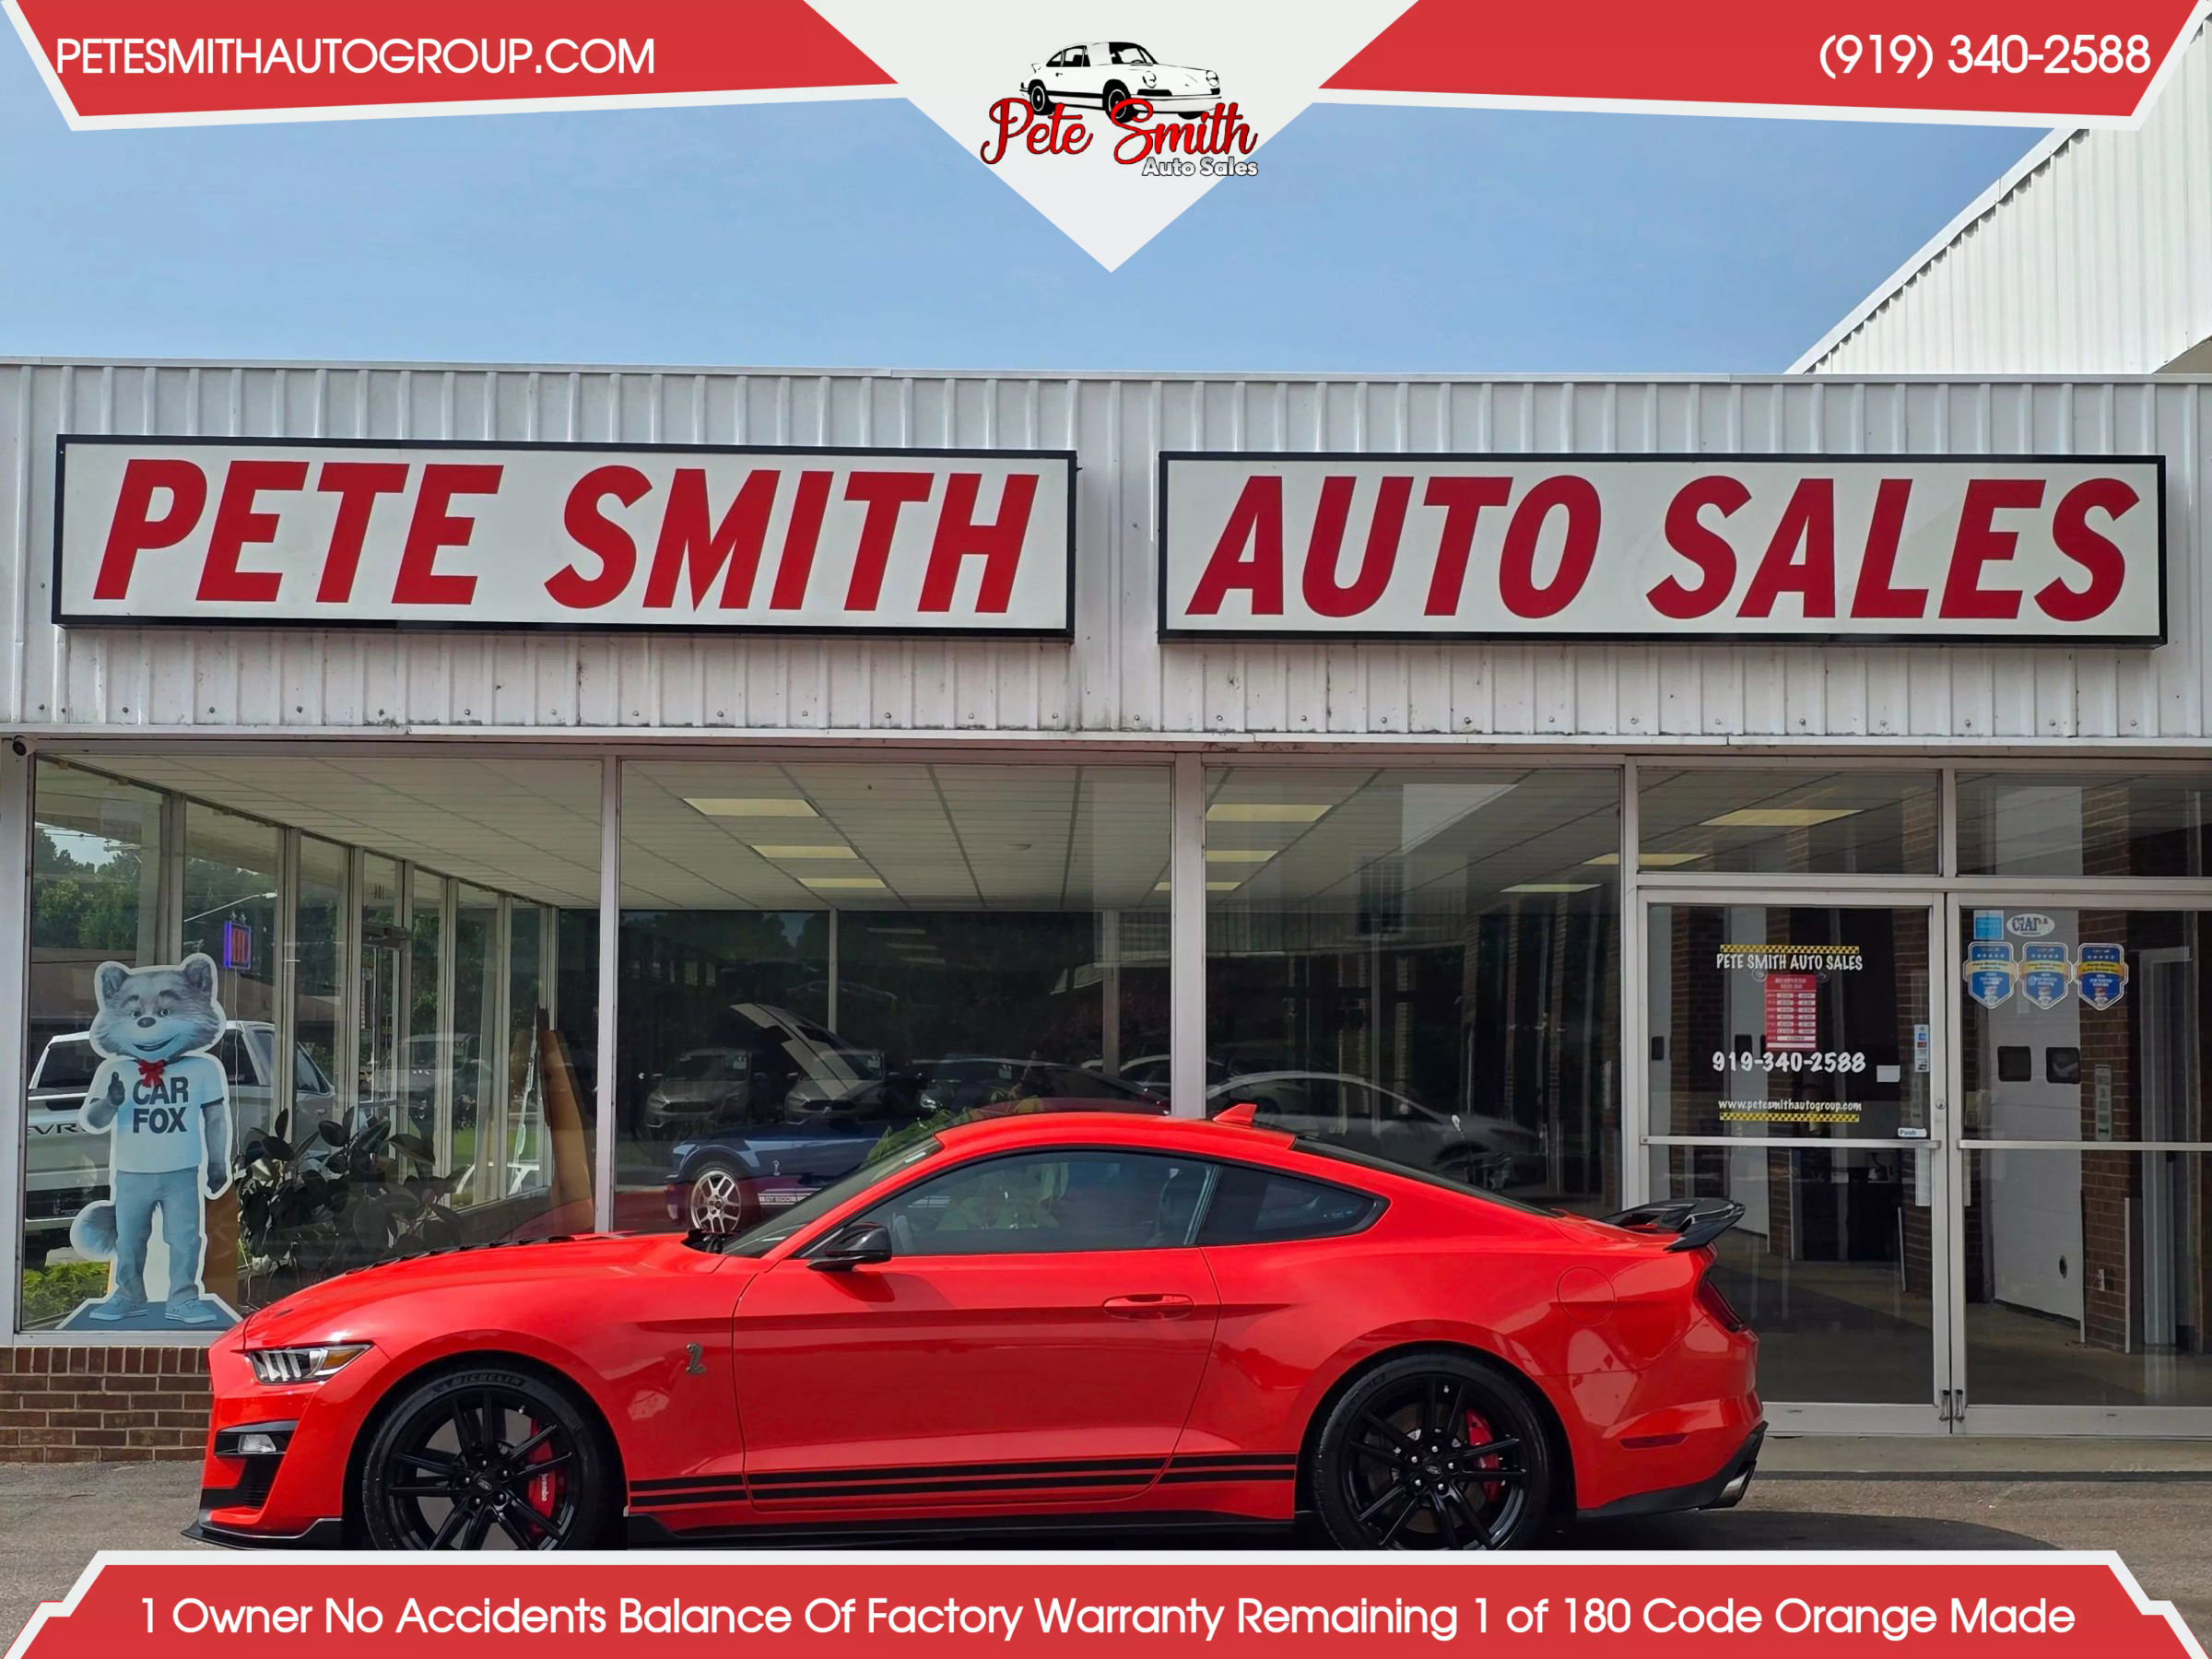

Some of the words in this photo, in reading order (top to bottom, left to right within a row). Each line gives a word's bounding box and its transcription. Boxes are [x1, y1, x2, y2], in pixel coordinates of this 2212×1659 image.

[93, 459, 503, 605] PETE
[545, 465, 1040, 614] SMITH
[1186, 475, 1602, 619] AUTO
[1647, 475, 2139, 622] SALES
[1716, 953, 1745, 969] PETE
[1747, 954, 1787, 970] SMITH
[1790, 955, 1823, 970] AUTO
[1826, 956, 1864, 971] SALES
[1712, 1052, 1866, 1073] 919-340-2588
[133, 1077, 189, 1105] CAR
[1718, 1098, 1862, 1112] www.petesmithautogroup.com
[133, 1107, 187, 1134] FOX
[451, 1372, 523, 1387] MICHELIN
